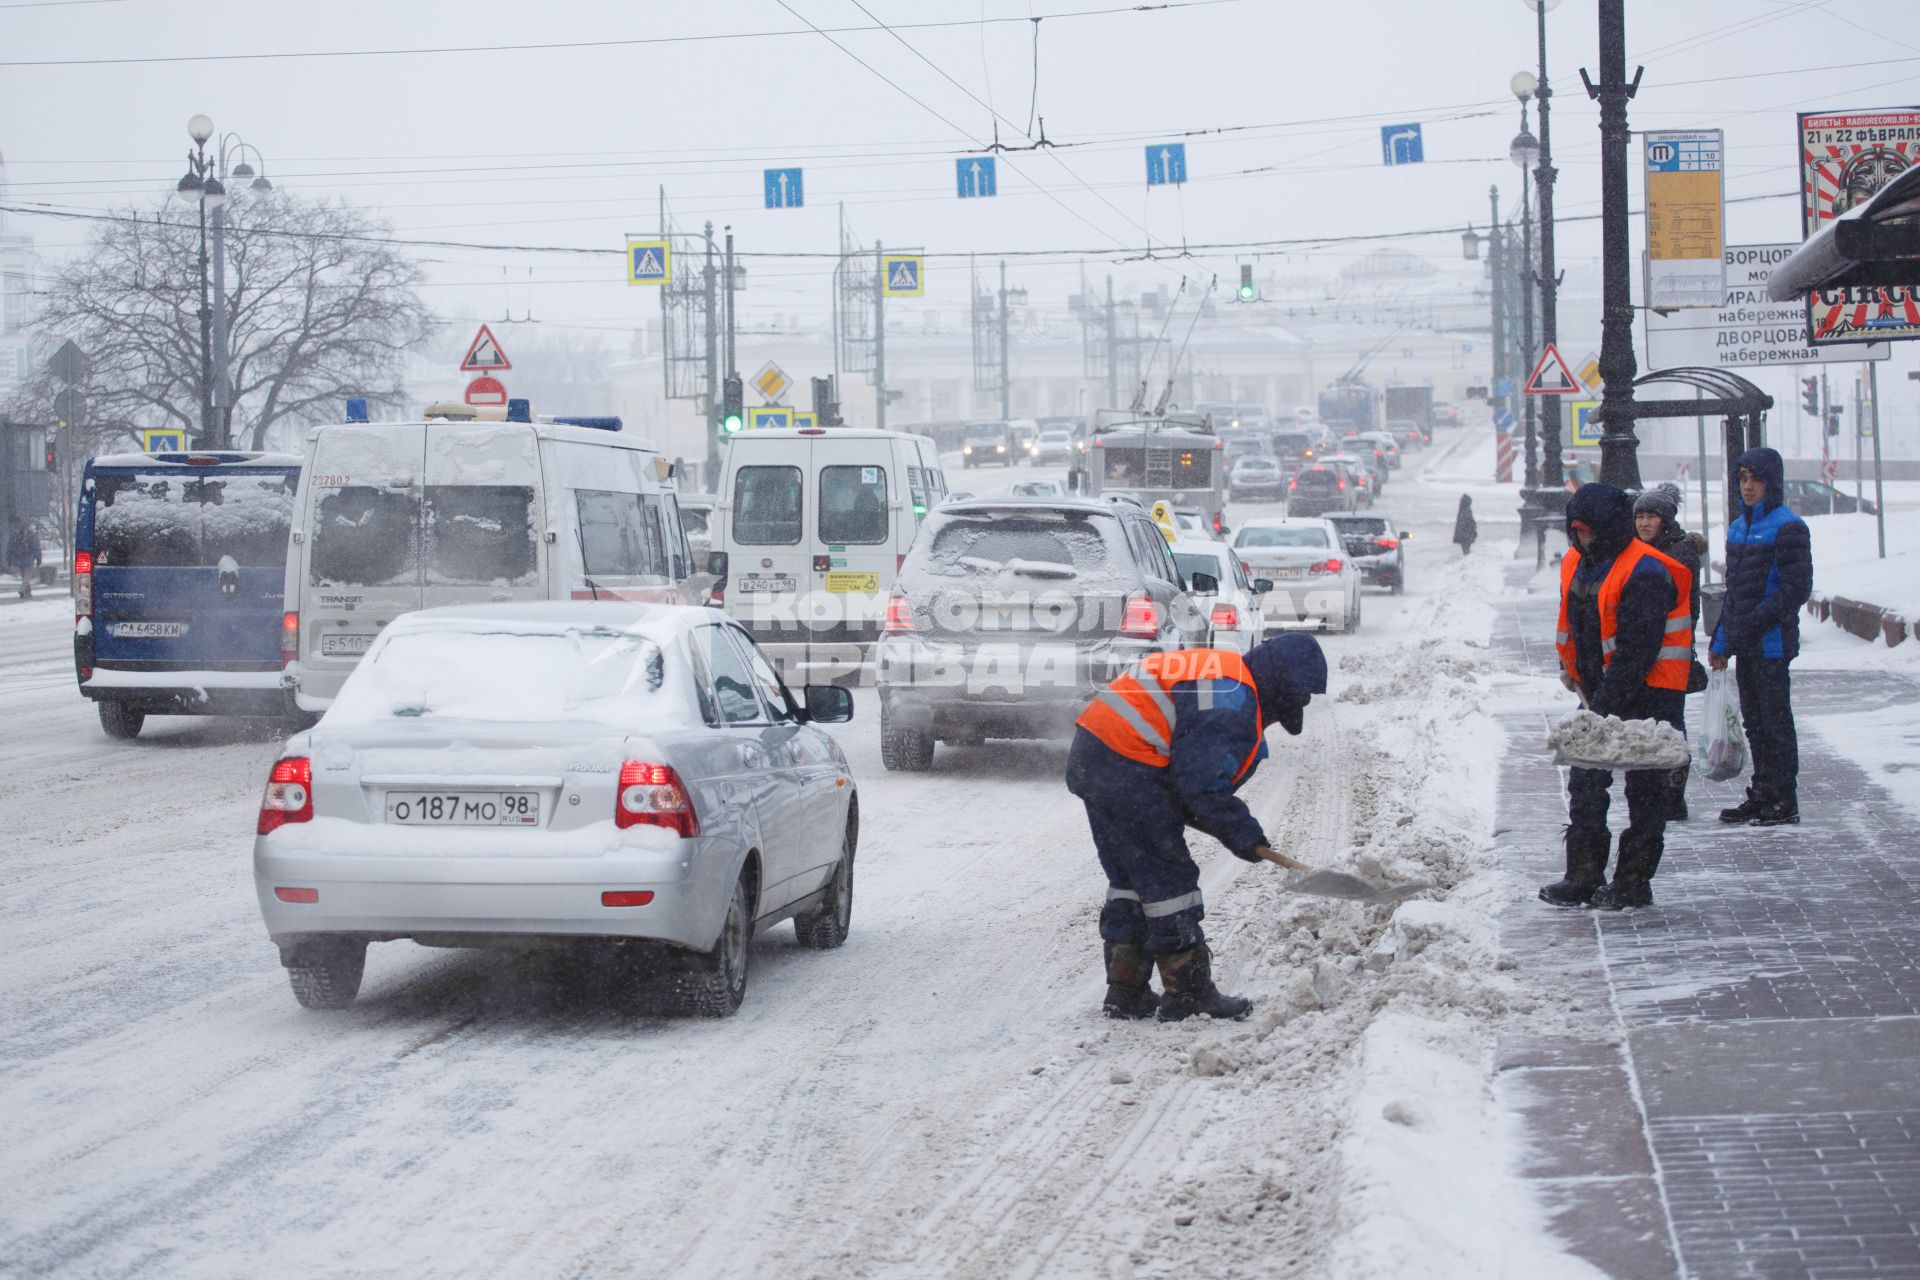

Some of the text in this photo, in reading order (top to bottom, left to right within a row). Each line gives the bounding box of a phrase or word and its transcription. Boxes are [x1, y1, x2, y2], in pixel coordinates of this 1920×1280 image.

[1808, 118, 1844, 128] БИЛЕТЫ:
[1807, 130, 1821, 144] 21
[1825, 133, 1832, 143] и
[1836, 129, 1852, 142] 22
[1718, 308, 1806, 324] набережна
[1716, 329, 1808, 347] ДВОРЦОВА
[1720, 348, 1819, 364] набережная
[320, 595, 364, 603] TRANSIT
[505, 796, 528, 814] 98
[502, 815, 520, 823] RUS
